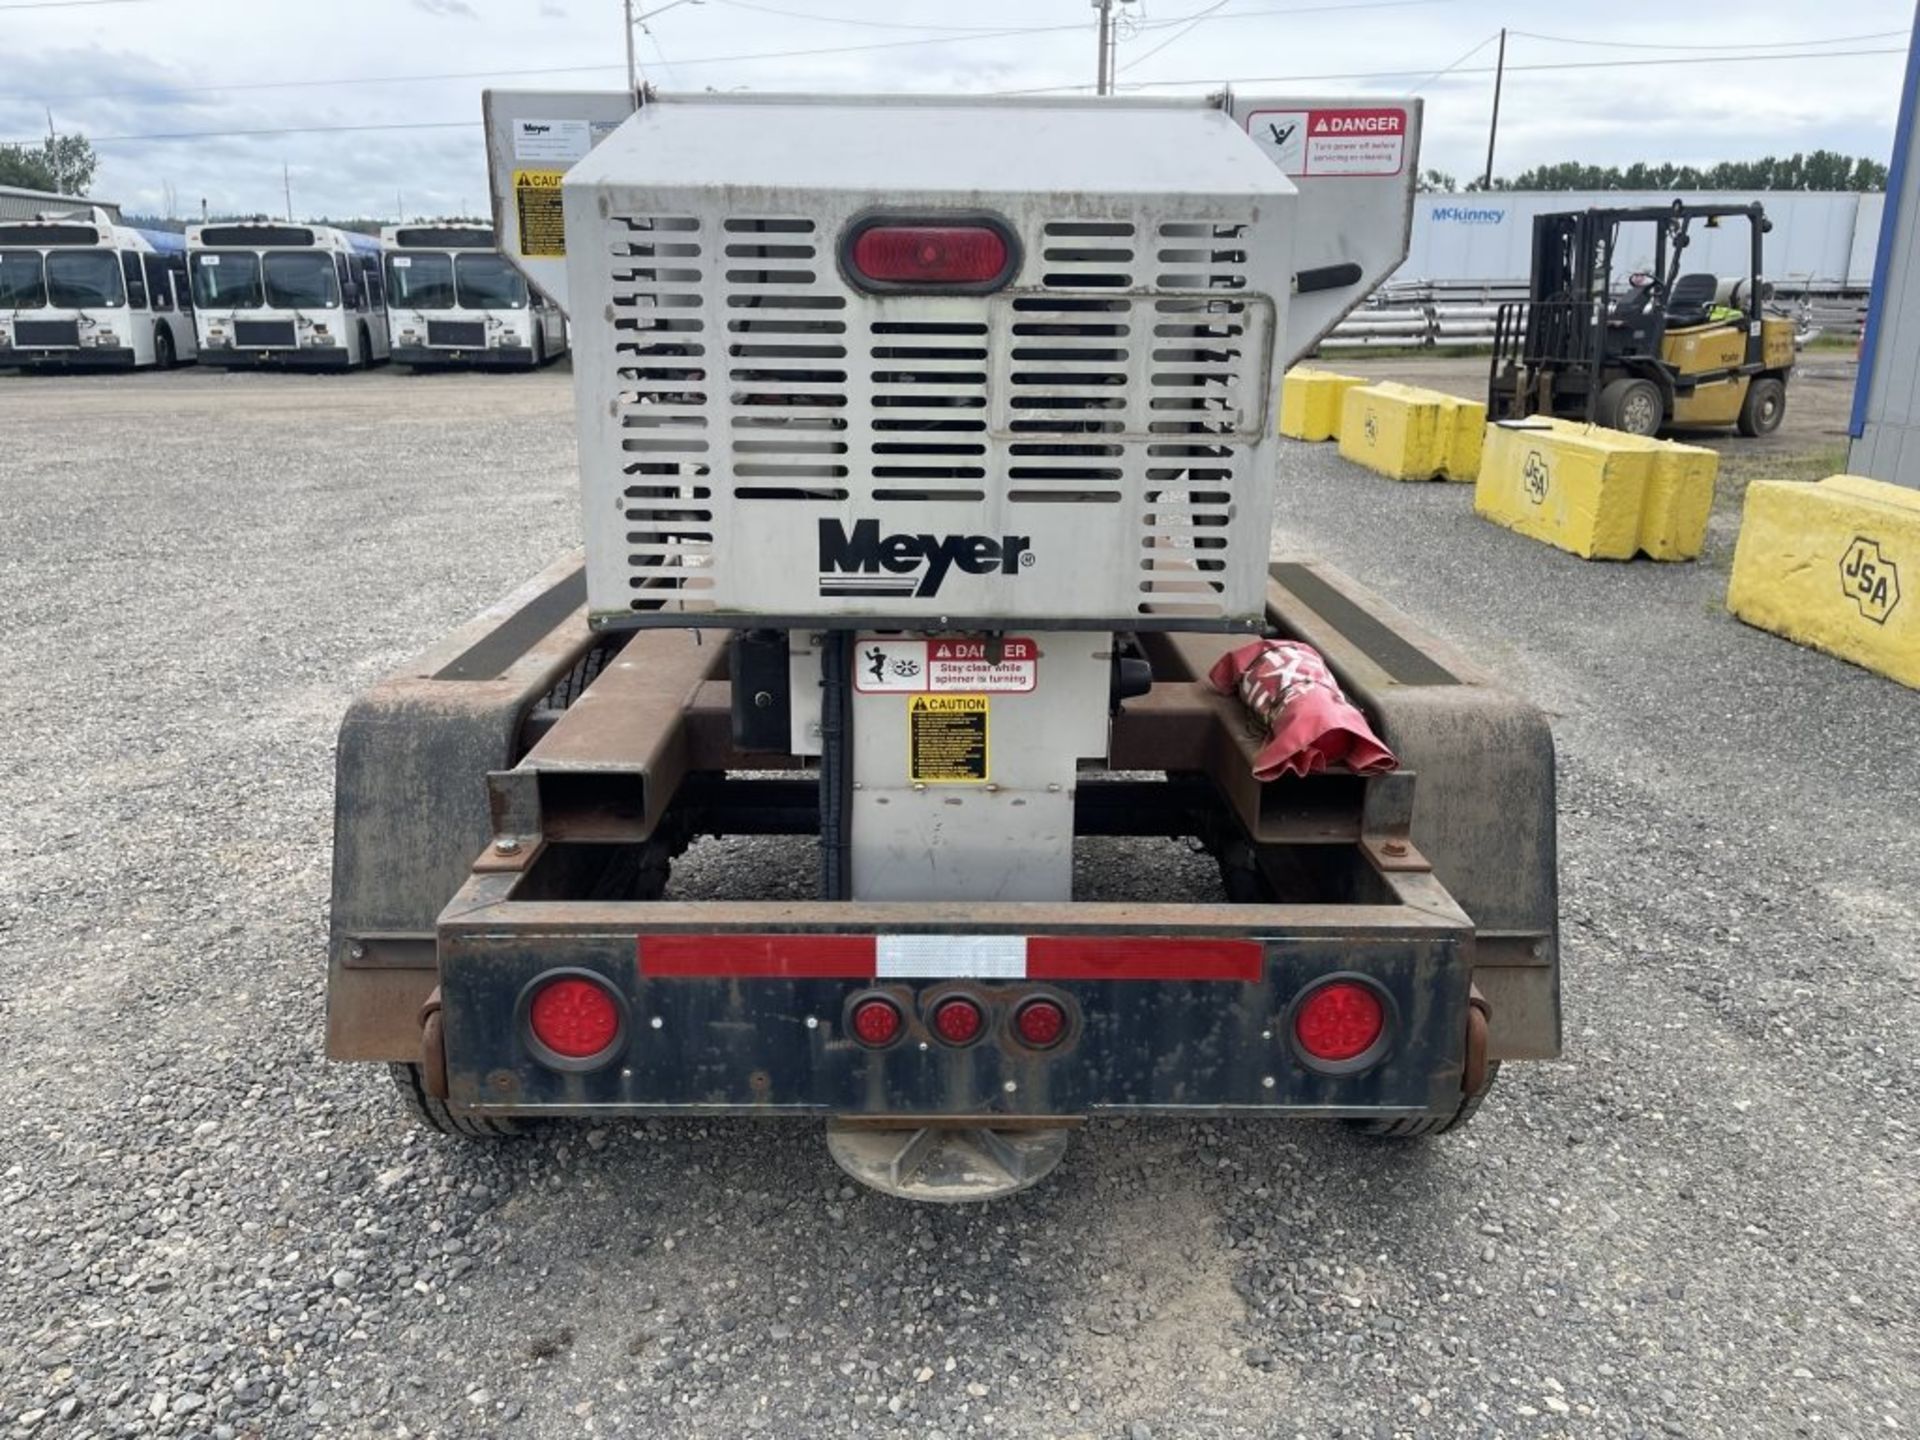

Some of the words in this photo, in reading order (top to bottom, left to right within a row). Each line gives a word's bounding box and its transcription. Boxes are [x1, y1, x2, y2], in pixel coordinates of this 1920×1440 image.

[523, 123, 550, 135] Meyer
[1331, 117, 1399, 132] DANGER
[818, 518, 1031, 598] Meyer
[1846, 548, 1888, 608] JSA
[955, 644, 1027, 657] DAER
[940, 663, 964, 673] Stay
[966, 663, 991, 672] clear
[994, 663, 1022, 672] while
[935, 675, 974, 685] spinner
[977, 675, 986, 683] is
[989, 674, 1026, 685] turning
[929, 699, 985, 710] CAUTION
